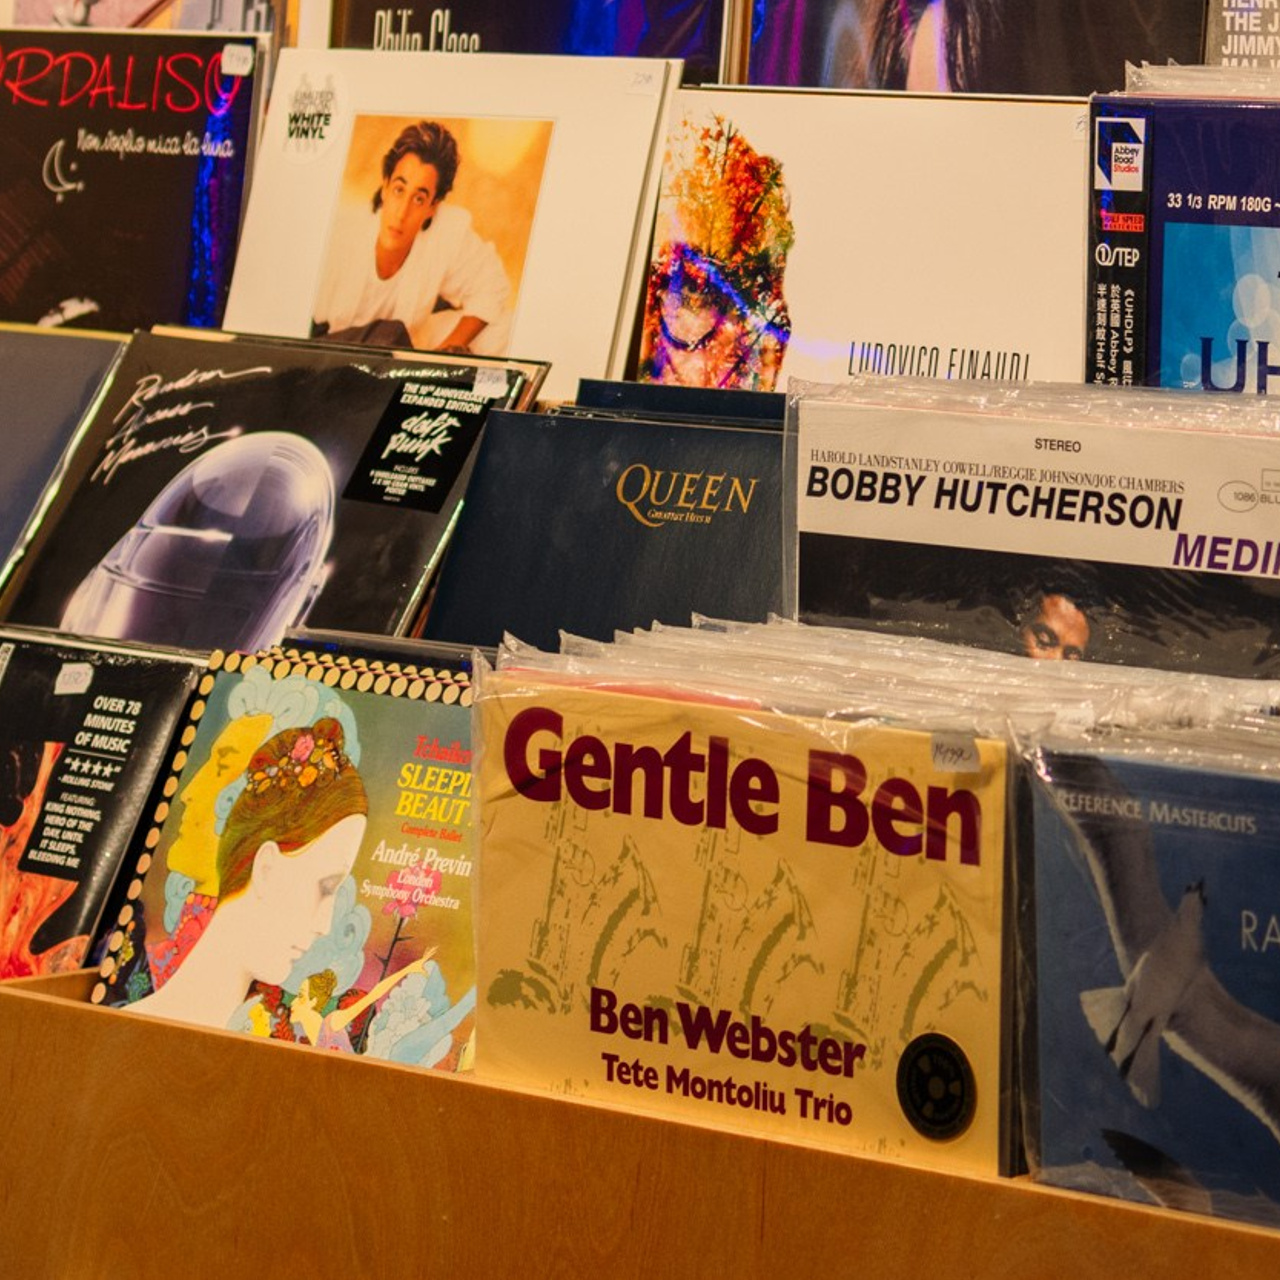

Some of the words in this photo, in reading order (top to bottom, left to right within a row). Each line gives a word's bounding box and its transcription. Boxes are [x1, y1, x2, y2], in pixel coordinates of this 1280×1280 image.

[1222, 12, 1261, 31] THE
[289, 113, 332, 127] WHITE
[288, 126, 326, 140] VINYL
[1114, 146, 1140, 158] Abbey
[1114, 155, 1135, 165] Road
[1114, 163, 1140, 174] Studios
[1167, 193, 1183, 208] 33
[1187, 194, 1202, 209] 1/3
[1208, 195, 1237, 211] RPM
[1240, 197, 1271, 213] 180G
[1107, 330, 1119, 373] Abbey
[402, 382, 421, 394] THE
[433, 386, 490, 404] ANNIVERSARY
[400, 394, 446, 408] EXPANDED
[445, 400, 482, 414] EDITION
[401, 411, 461, 439] daft
[381, 430, 452, 462] punk
[1034, 437, 1082, 453] STEREO
[810, 449, 857, 465] HAROLD
[1118, 476, 1185, 494] CHAMBERS
[616, 463, 759, 528] QUEEN
[806, 465, 927, 506] BOBBY
[934, 476, 1183, 531] HUTCHERSON
[93, 695, 125, 713] OVER
[125, 700, 142, 716] 78
[83, 713, 136, 734] MINUTES
[74, 731, 92, 747] OF
[91, 734, 131, 753] MUSIC
[504, 706, 781, 836] Gentle
[806, 748, 981, 866] Ben
[44, 802, 67, 815] KING
[43, 815, 66, 828] HERO
[66, 818, 78, 829] OF
[77, 820, 94, 832] THE
[60, 830, 83, 844] UNTIL
[27, 850, 65, 865] BLEEDING
[65, 855, 80, 868] ME
[371, 839, 420, 867] André
[422, 847, 472, 877] Previn
[397, 869, 433, 888] London
[360, 879, 411, 904] Symphony
[412, 888, 461, 910] Orchestra
[589, 986, 669, 1044] Ben
[677, 1002, 866, 1079] Webster
[601, 1052, 658, 1090] Tete
[666, 1067, 786, 1117] Montoliu
[795, 1088, 853, 1127] Trio
